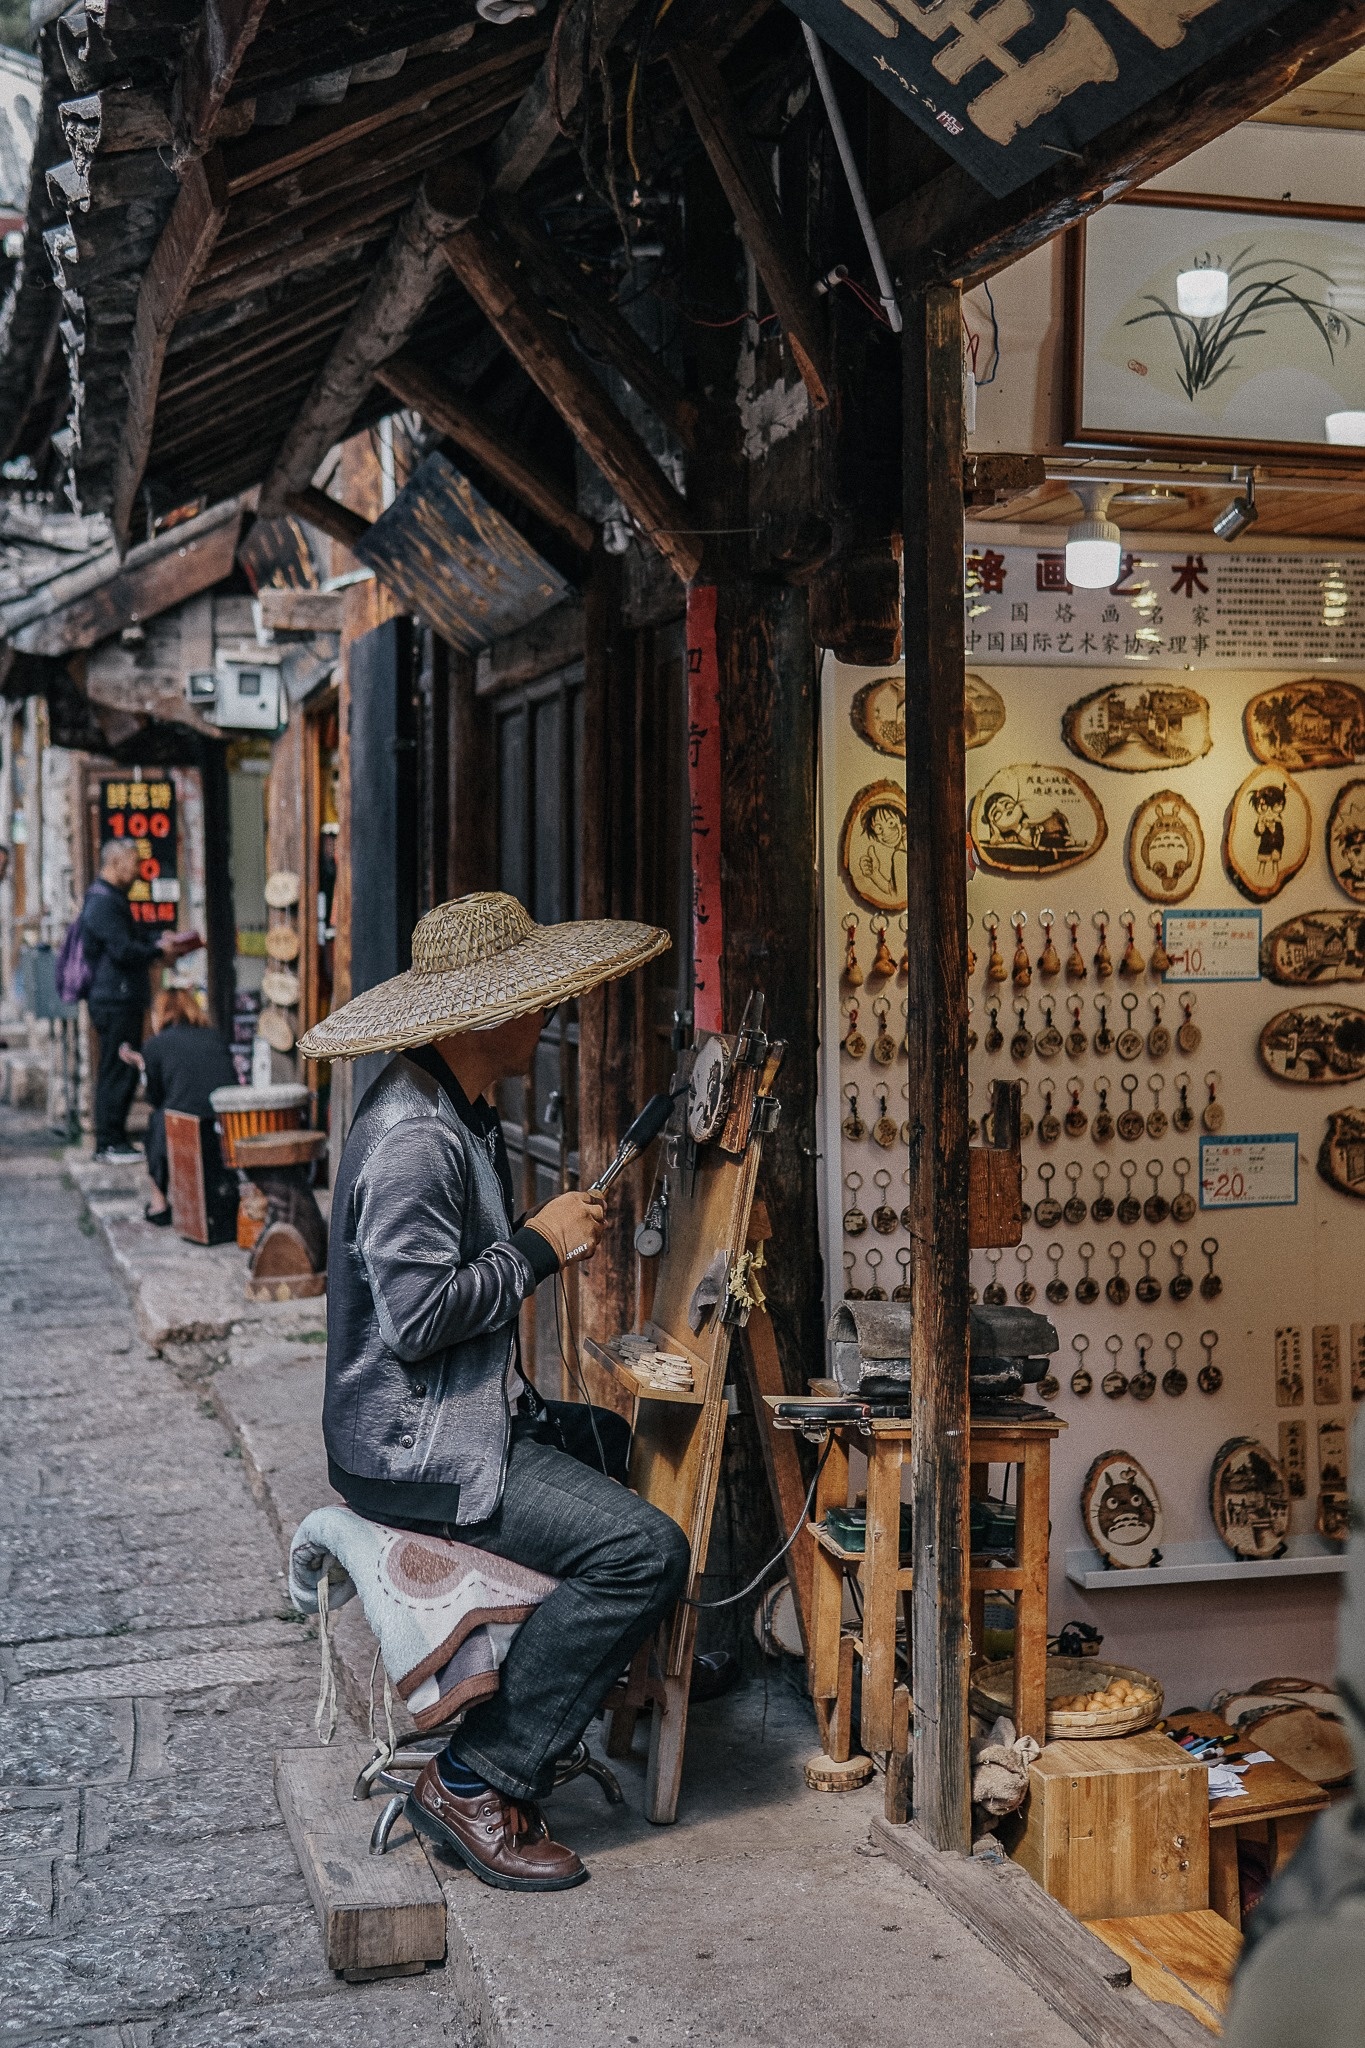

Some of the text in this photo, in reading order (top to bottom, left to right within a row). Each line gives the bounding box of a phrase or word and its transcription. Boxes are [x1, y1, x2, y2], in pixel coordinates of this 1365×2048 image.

[966, 630, 1210, 658] 中国国际艺术家协会理事
[107, 812, 171, 838] 100
